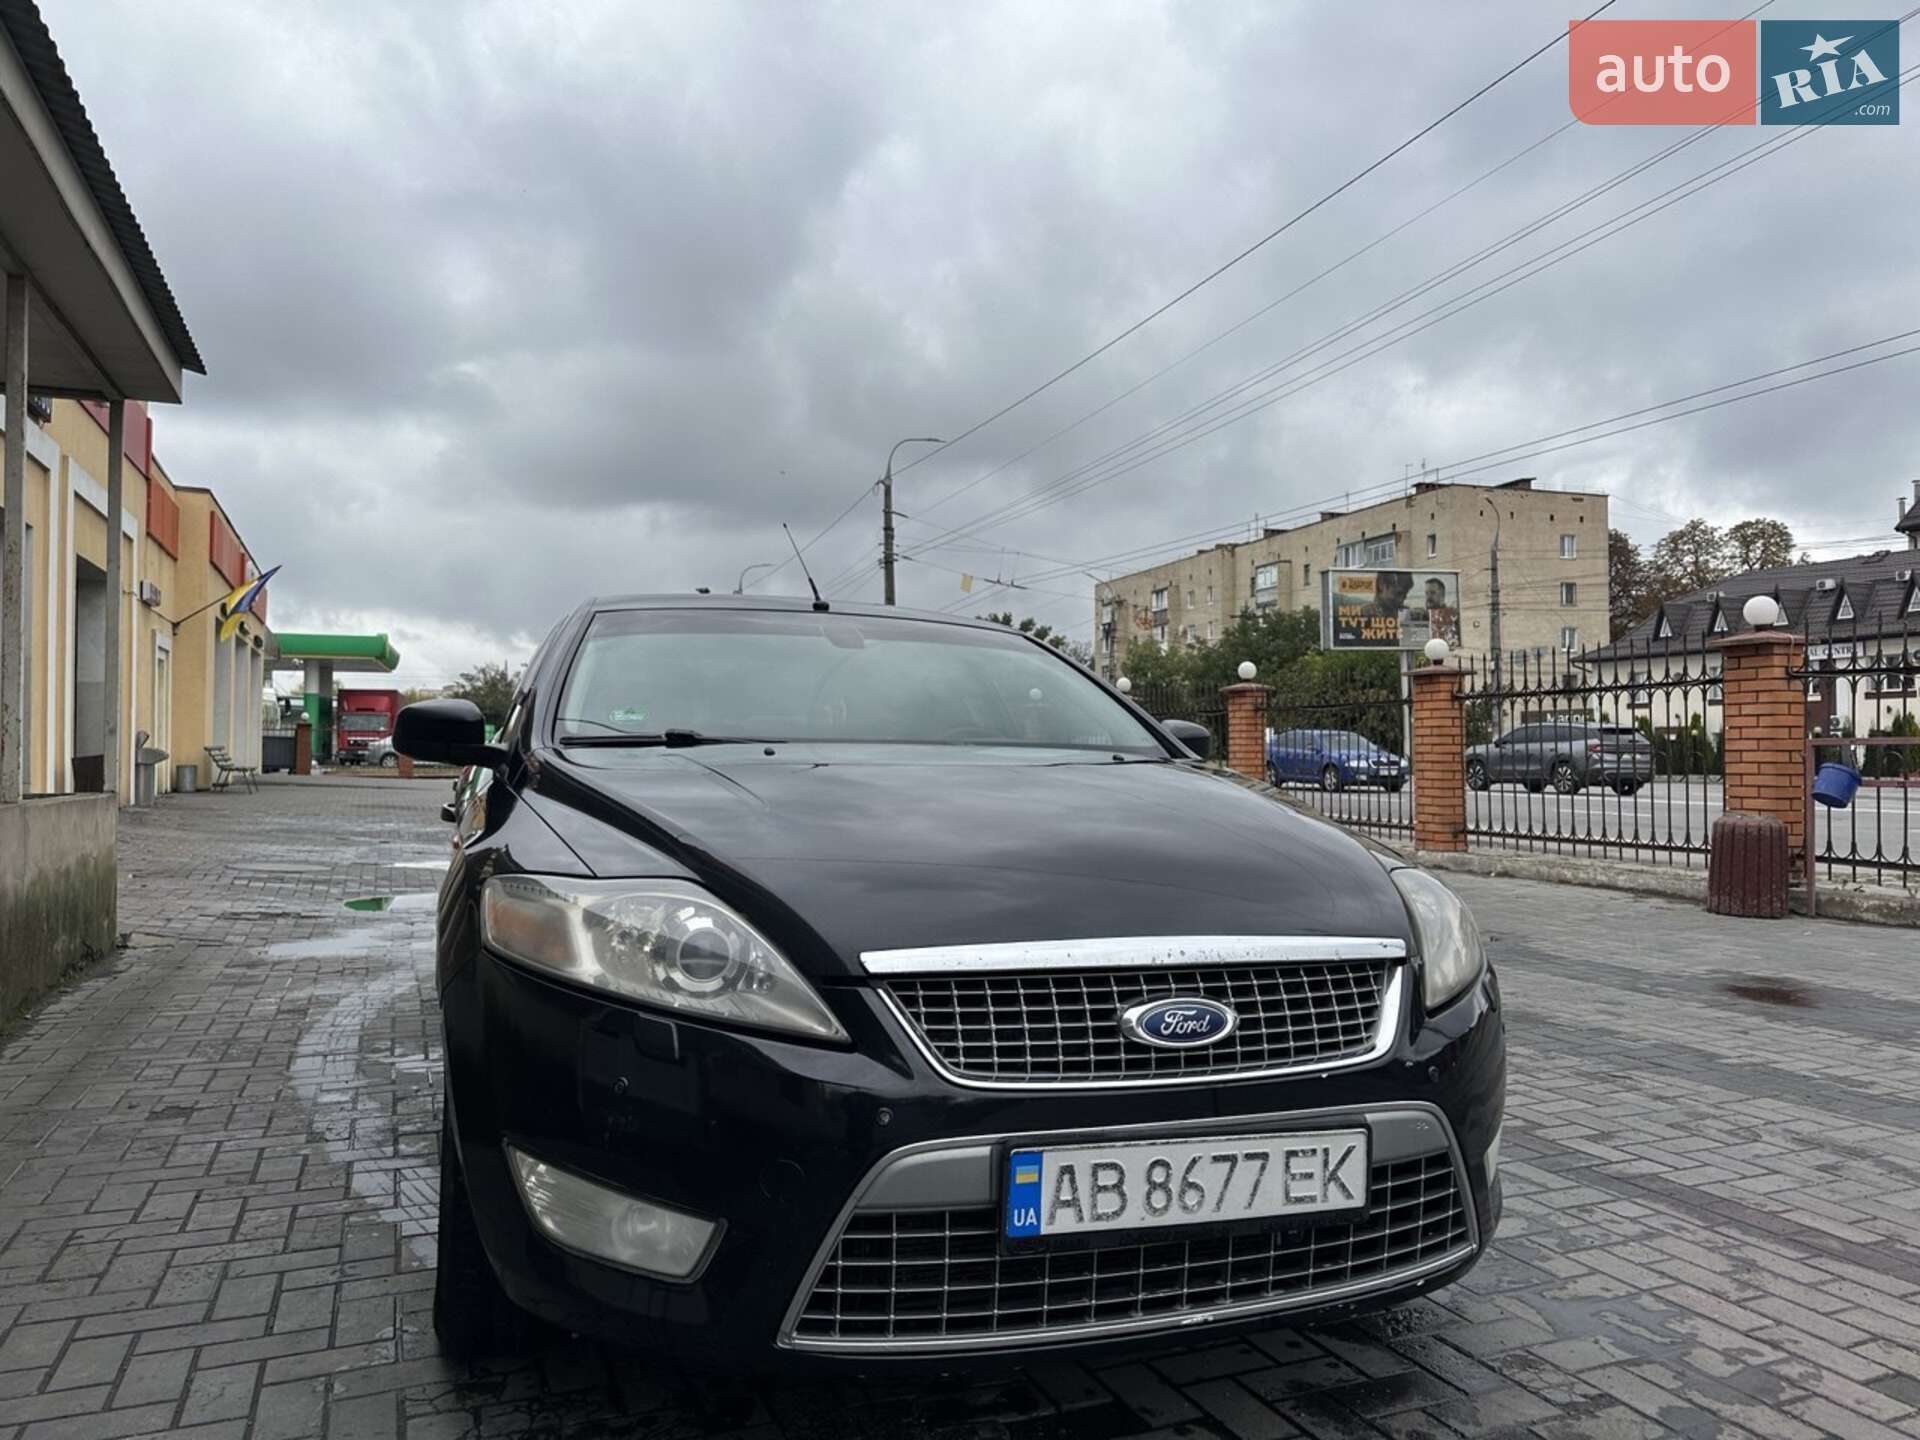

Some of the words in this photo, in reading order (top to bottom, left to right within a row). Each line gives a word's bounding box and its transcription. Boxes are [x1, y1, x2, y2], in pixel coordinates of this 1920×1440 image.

[1160, 1009, 1211, 1035] Ford
[1046, 1160, 1128, 1225] AB
[1143, 1150, 1270, 1217] 8677
[1283, 1145, 1357, 1206] EK
[1013, 1208, 1038, 1227] UA
